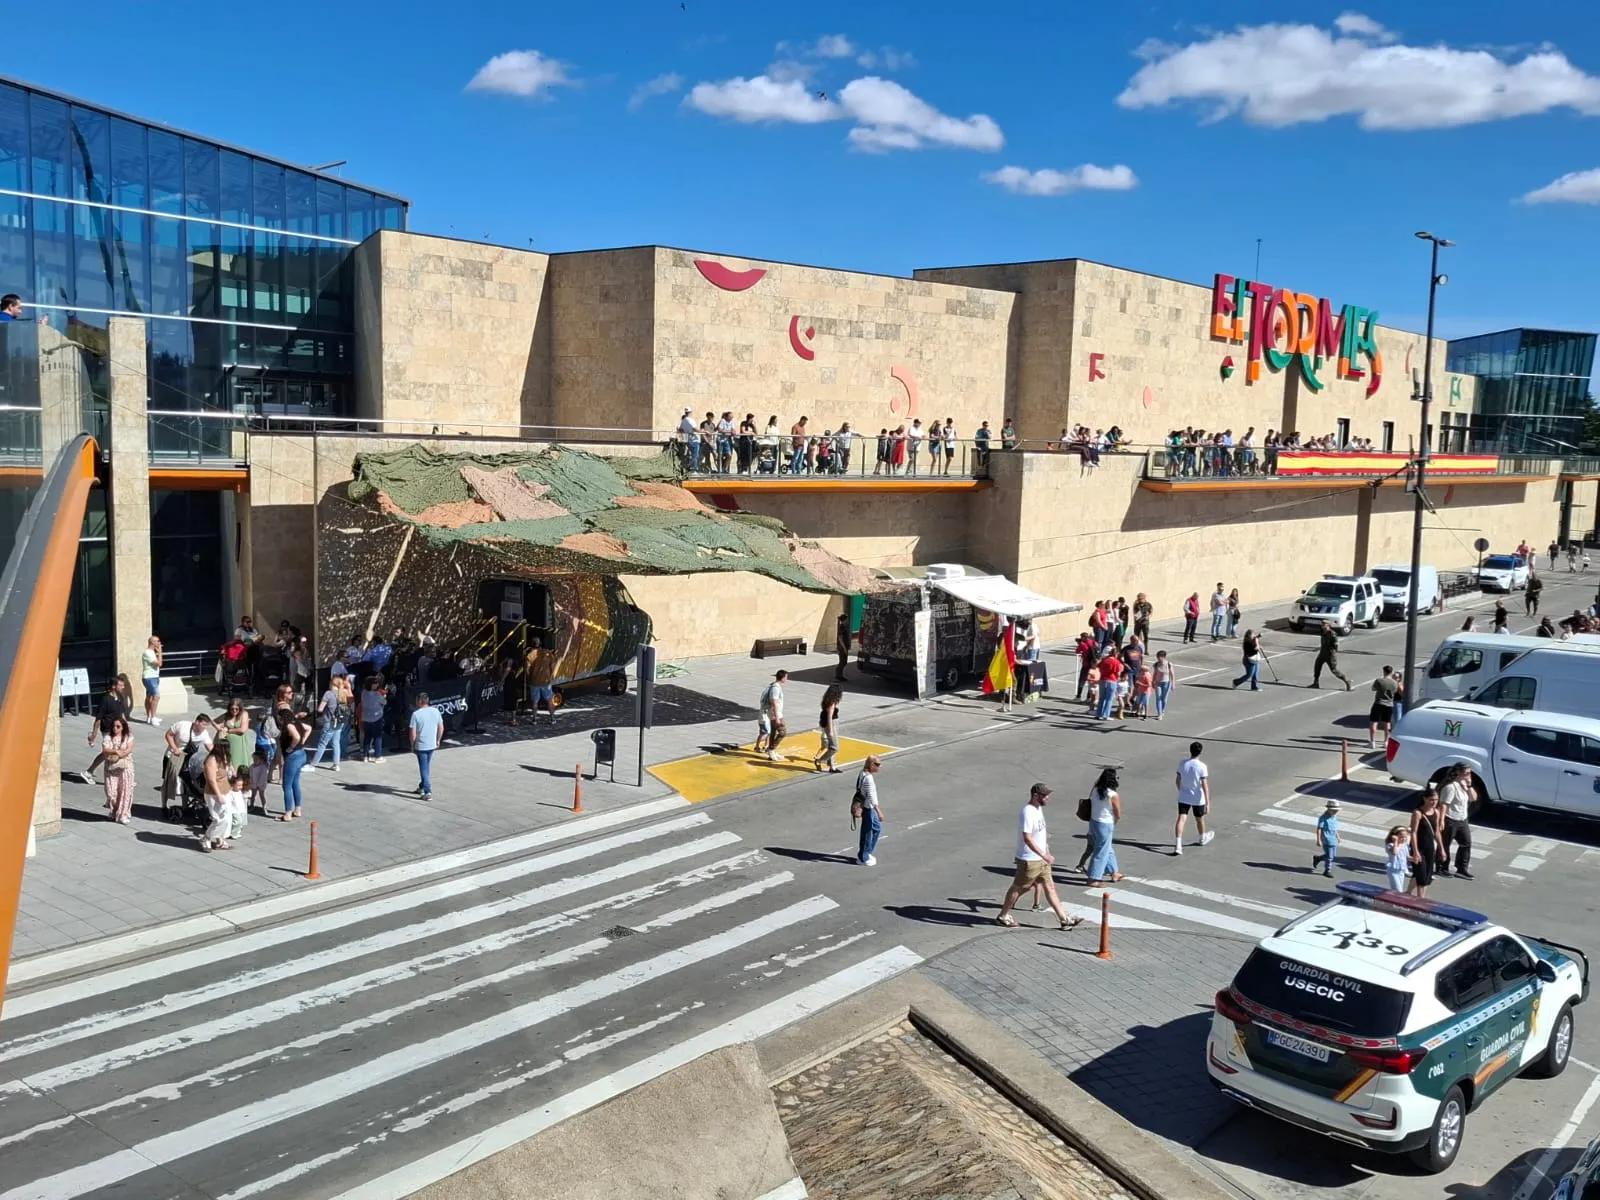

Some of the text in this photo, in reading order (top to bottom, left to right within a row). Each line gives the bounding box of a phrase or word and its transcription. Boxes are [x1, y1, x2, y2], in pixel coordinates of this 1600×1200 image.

[1248, 280, 1383, 400] TORMES
[1306, 925, 1409, 956] 2439
[1280, 961, 1362, 994] GUARDIA CIVIL
[1284, 975, 1345, 1002] USECIC
[1480, 1032, 1509, 1062] GUARDIA
[1510, 1021, 1525, 1041] CIVIL
